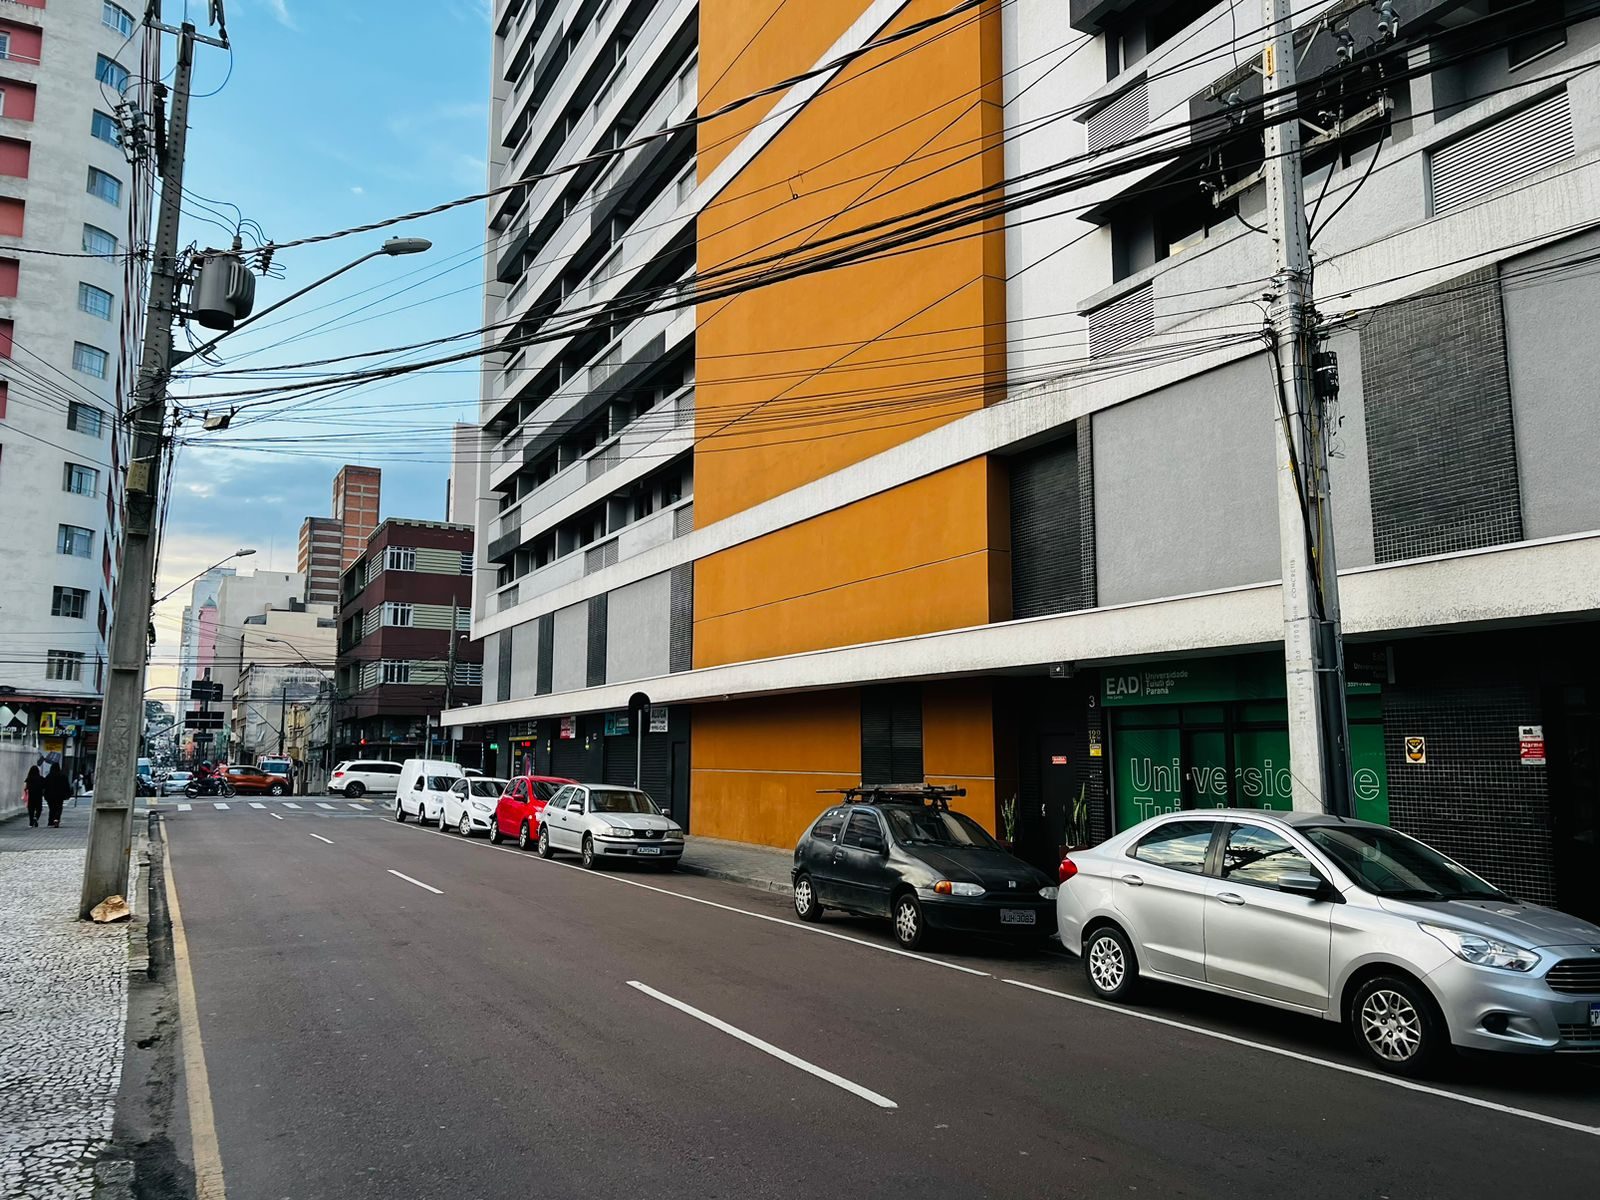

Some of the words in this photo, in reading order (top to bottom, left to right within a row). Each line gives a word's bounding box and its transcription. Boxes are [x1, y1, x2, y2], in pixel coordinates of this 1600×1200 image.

[1145, 670, 1188, 679] Universidade
[1106, 677, 1139, 695] EAD
[1131, 758, 1380, 800] Univeside
